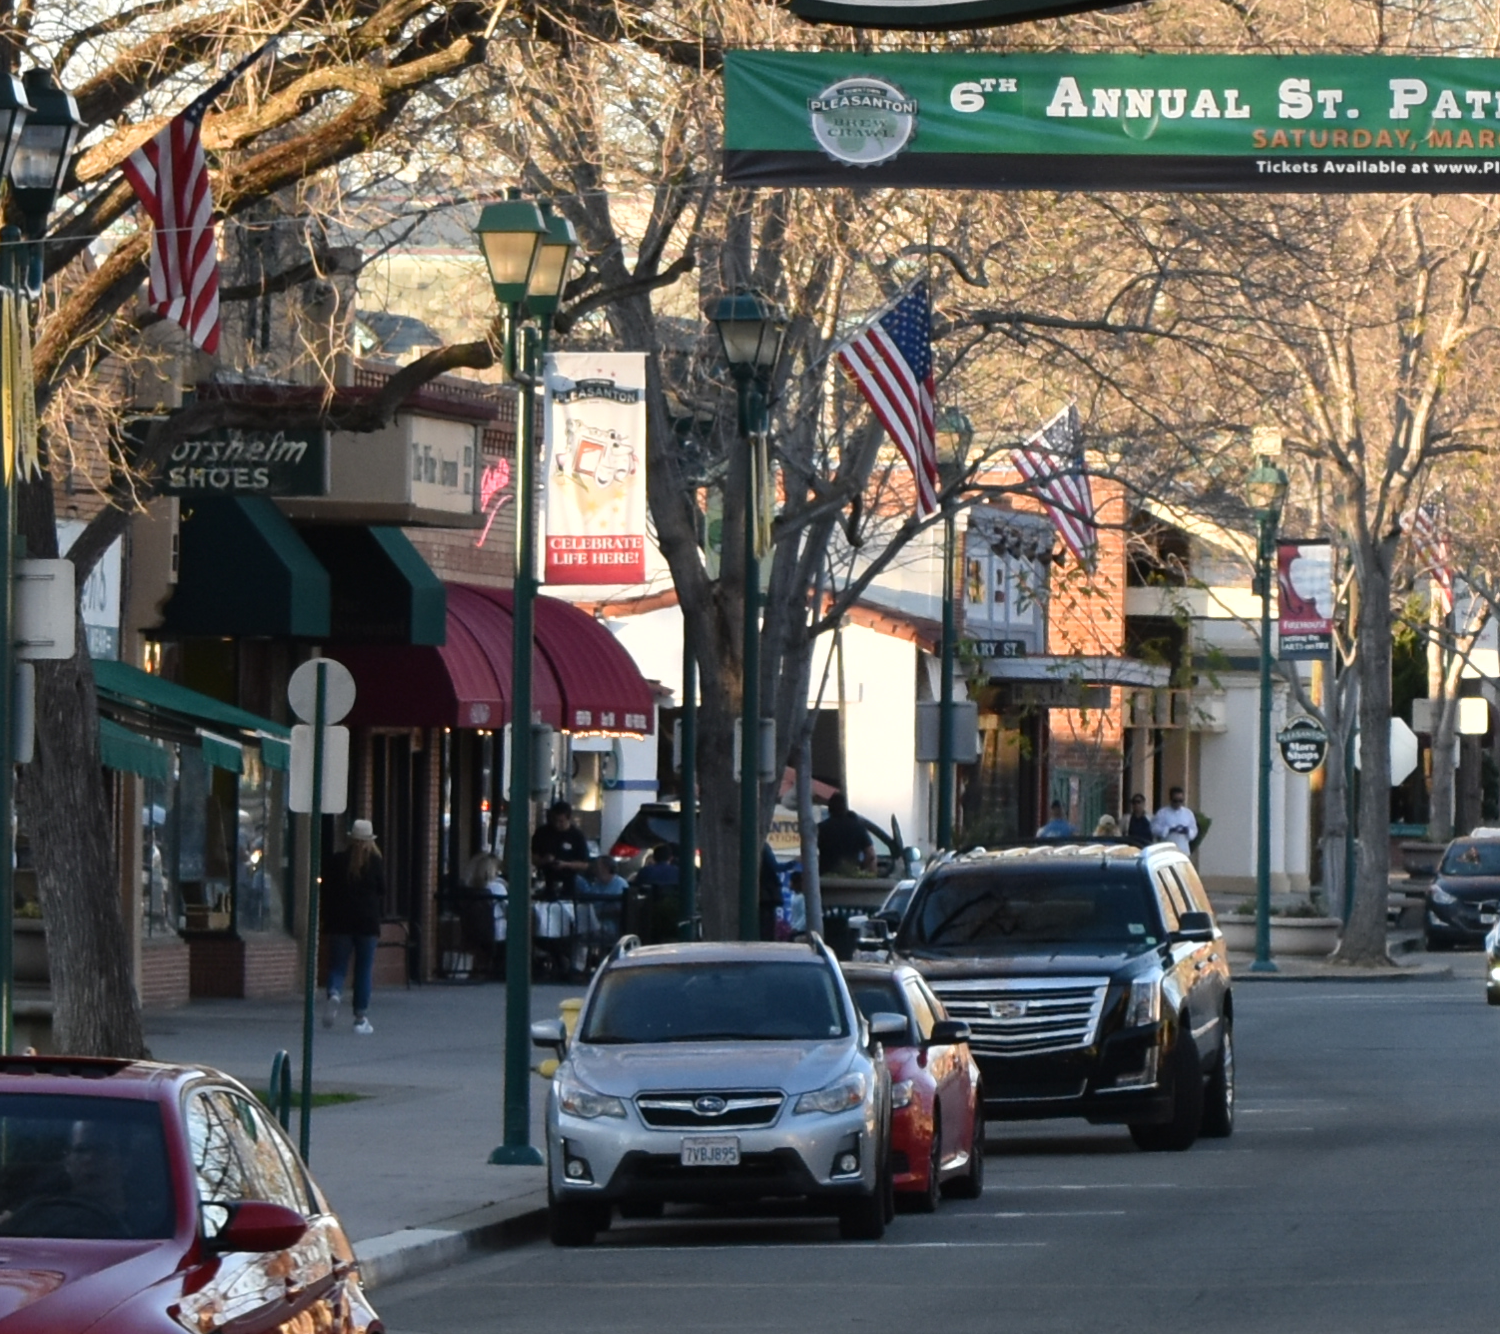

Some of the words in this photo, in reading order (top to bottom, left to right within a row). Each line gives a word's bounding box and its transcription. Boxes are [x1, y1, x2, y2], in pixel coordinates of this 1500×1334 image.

[810, 95, 913, 113] PLEASANTON
[1252, 128, 1416, 151] SATURDAY,
[1256, 160, 1318, 175] Tickets
[1323, 160, 1407, 175] Available
[1411, 161, 1429, 175] at
[555, 387, 637, 403] PLEASANTON
[168, 467, 270, 489] SHOES
[550, 536, 643, 550] CELEBRATE
[553, 552, 588, 565] LIFE
[592, 552, 640, 565] HERE!
[1286, 750, 1320, 762] Shops
